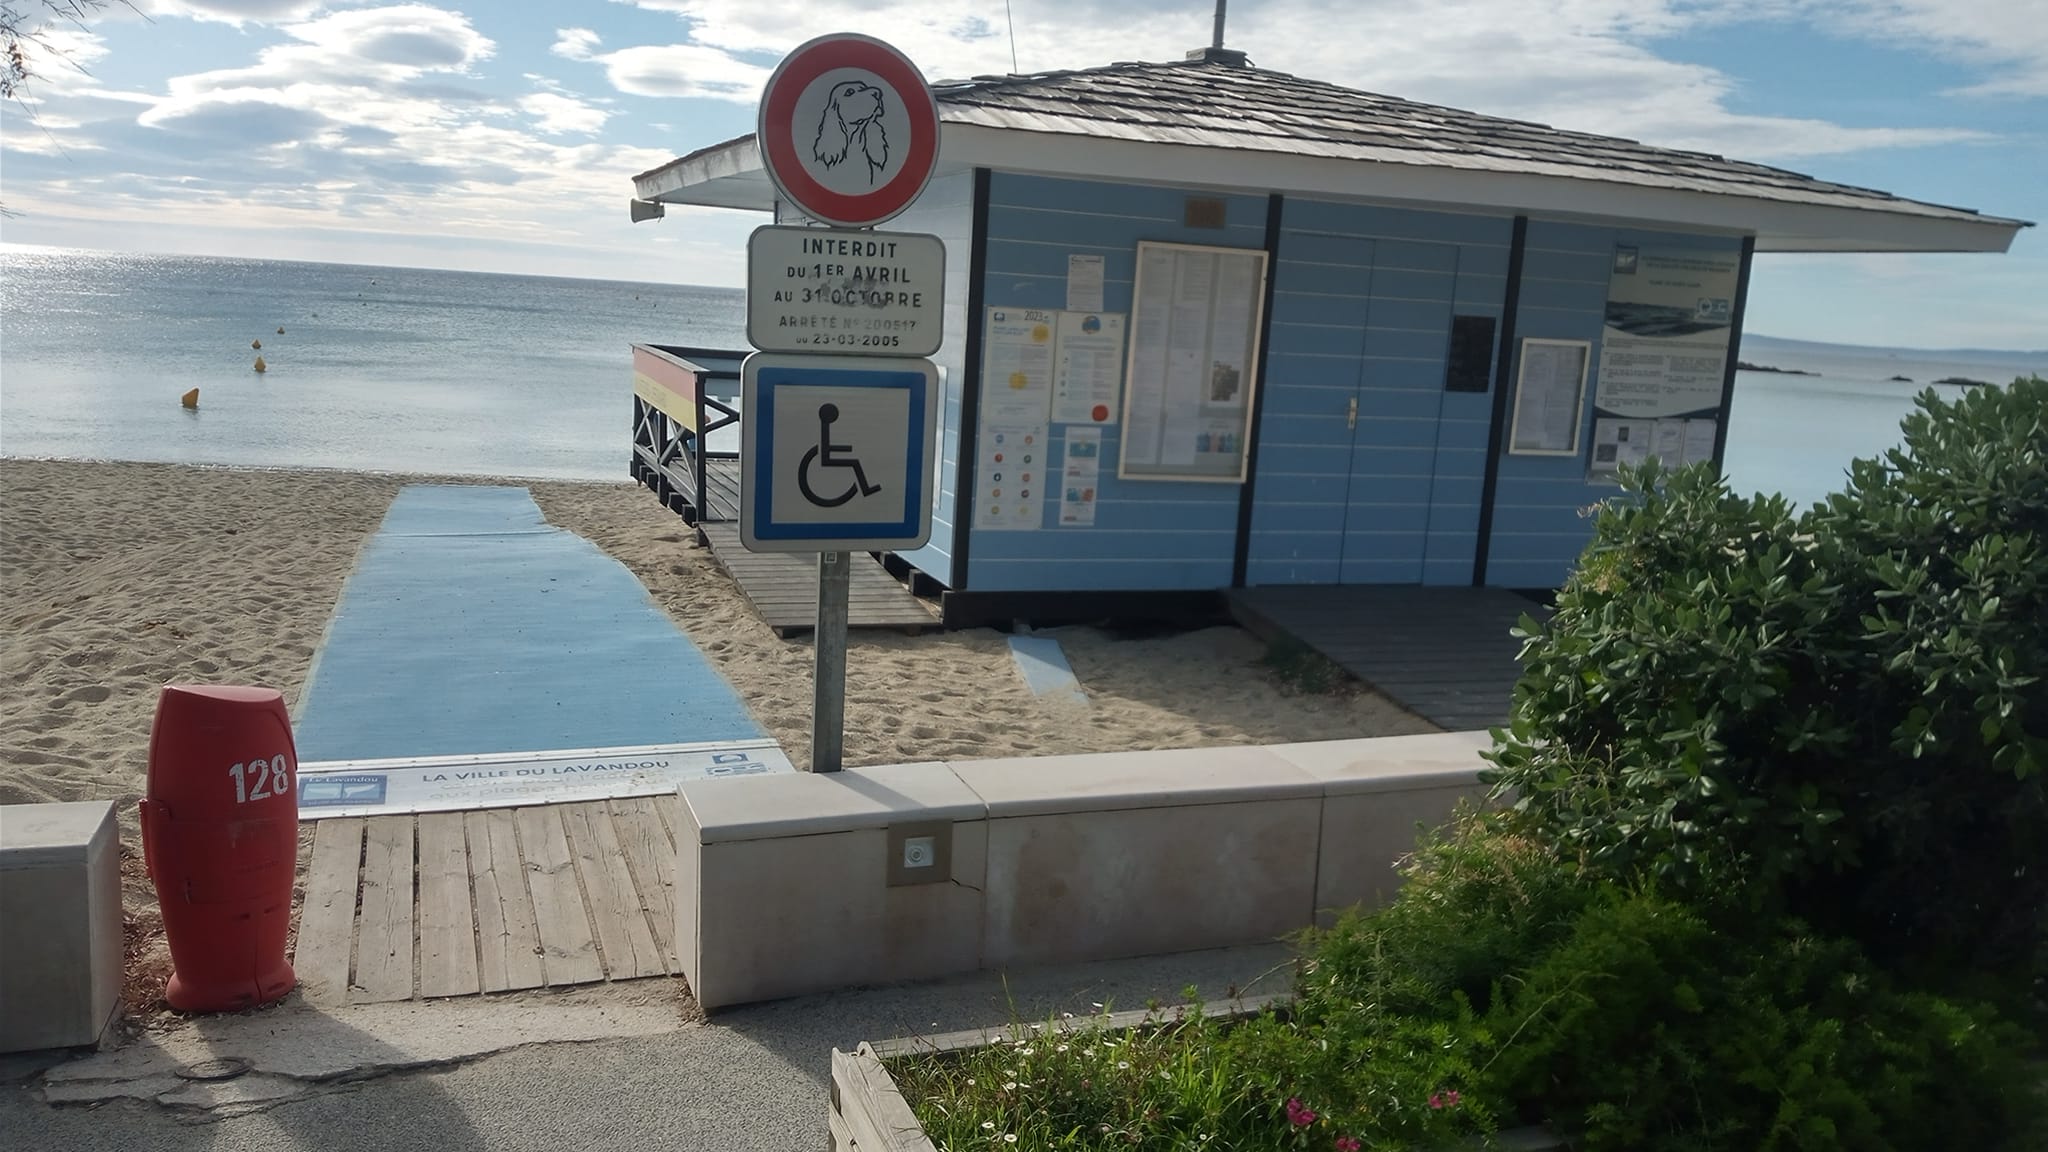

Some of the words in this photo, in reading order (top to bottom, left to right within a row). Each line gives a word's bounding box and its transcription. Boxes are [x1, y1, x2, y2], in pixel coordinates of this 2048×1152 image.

[802, 238, 897, 258] INTERDIT
[787, 266, 806, 278] DU
[852, 265, 911, 283] AVRIL
[774, 290, 793, 302] AU
[801, 287, 822, 303] 31
[831, 288, 922, 308] OCTOBRE
[229, 753, 288, 804] 128
[423, 773, 448, 782] LA
[455, 770, 508, 780] VILLE
[516, 768, 546, 777] DU
[552, 760, 670, 775] LAVANDOU
